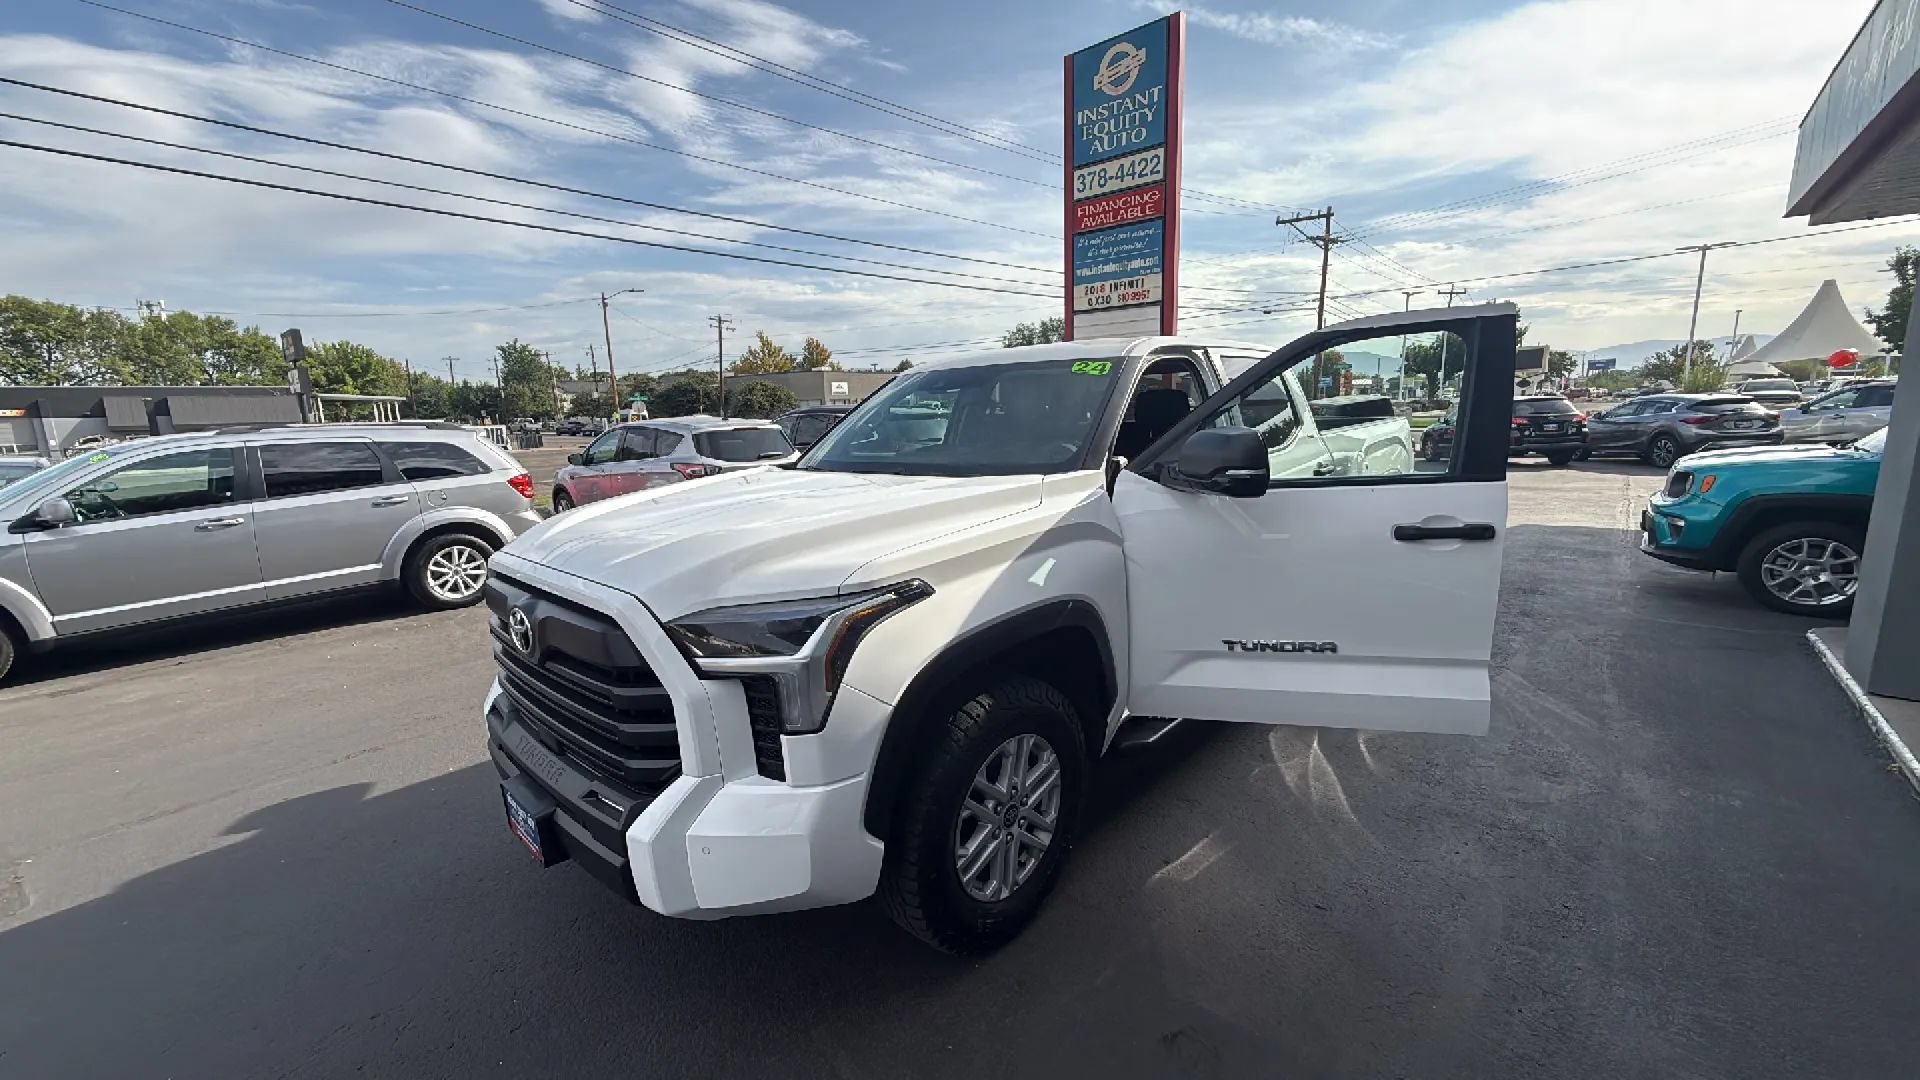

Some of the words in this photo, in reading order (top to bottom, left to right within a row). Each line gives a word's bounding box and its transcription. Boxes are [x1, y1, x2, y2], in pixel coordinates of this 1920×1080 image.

[1077, 85, 1163, 126] INSTANT
[1082, 104, 1157, 141] EQUITY
[1089, 127, 1147, 155] AUTO
[1077, 154, 1161, 193] 378-4422
[1077, 190, 1161, 217] FINANCING
[1081, 204, 1155, 229] AVAILABLE
[1084, 283, 1106, 296] 2018
[1109, 278, 1145, 293] INFINITI
[1221, 639, 1339, 654] TUNDRA
